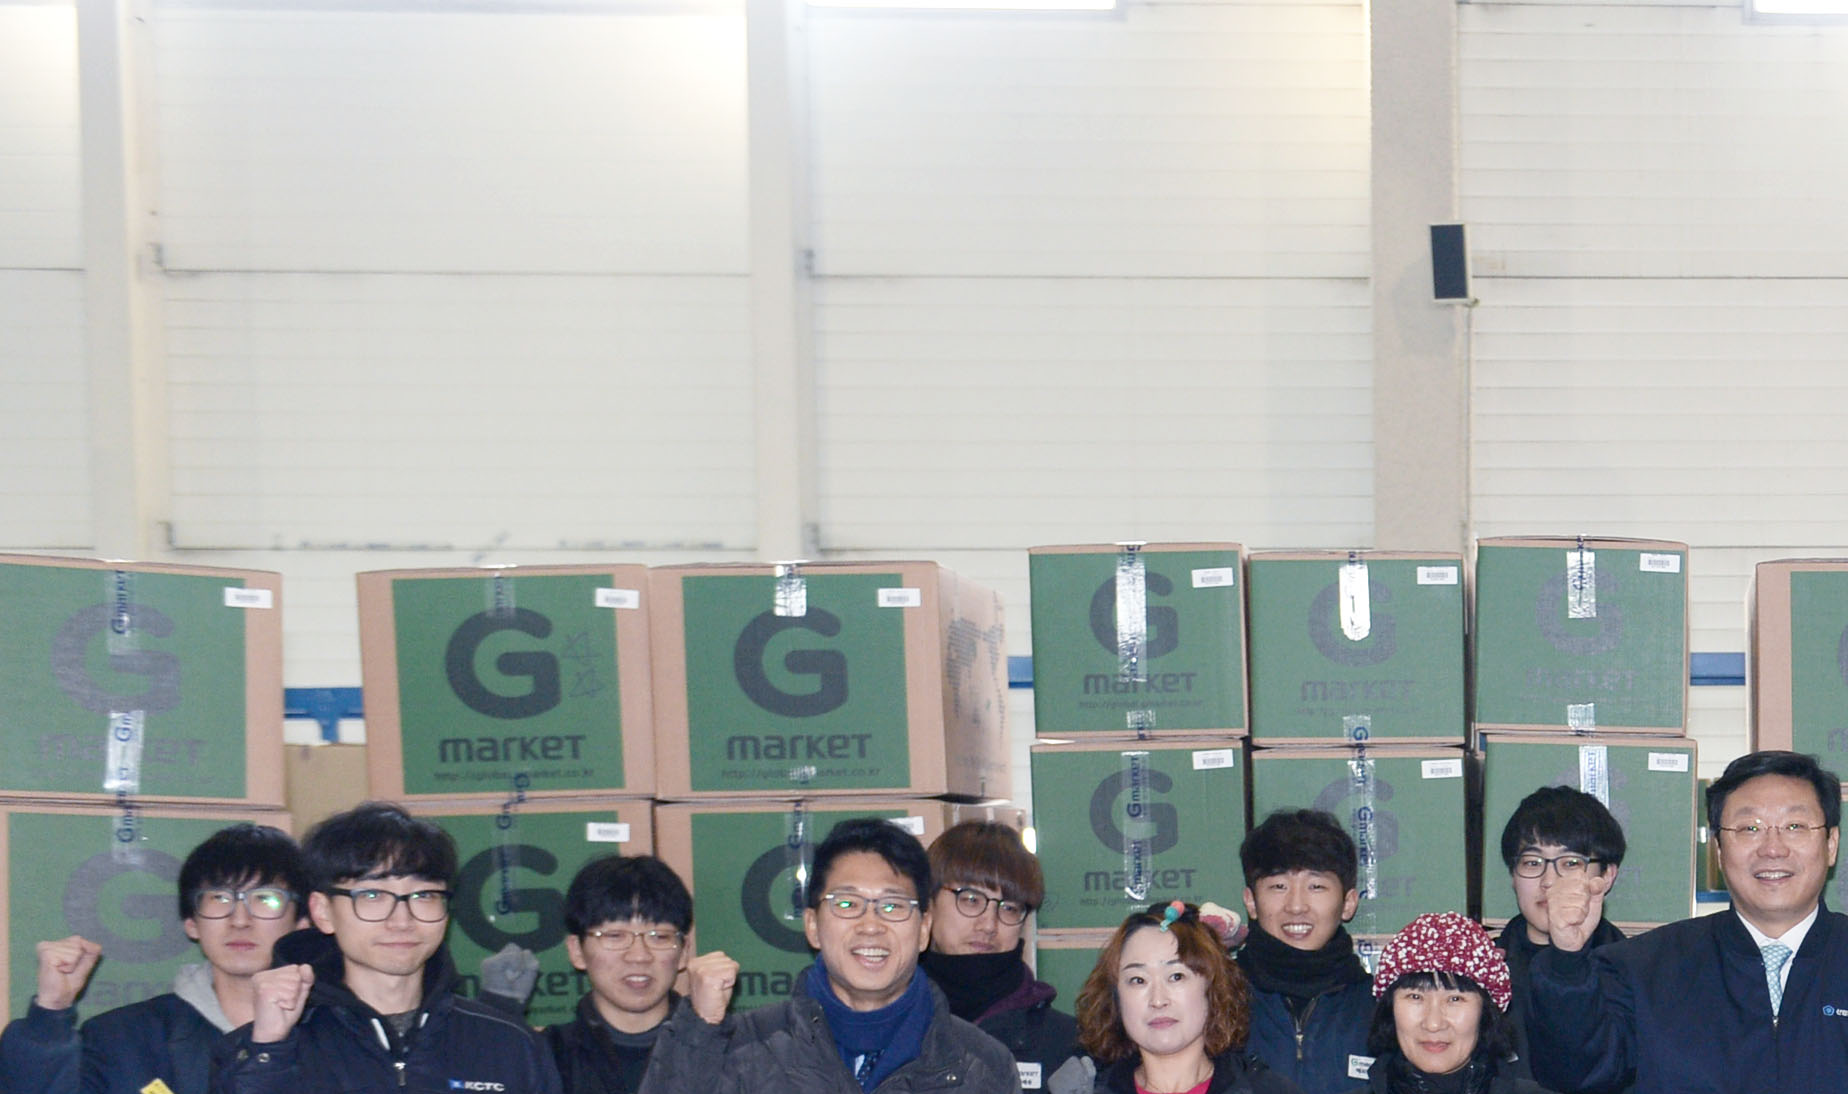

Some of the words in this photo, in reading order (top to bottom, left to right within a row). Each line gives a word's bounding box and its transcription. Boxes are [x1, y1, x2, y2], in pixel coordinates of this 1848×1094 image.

[1089, 572, 1178, 659] G
[1307, 578, 1397, 667] G
[53, 602, 182, 716] G
[445, 607, 561, 720] G
[734, 606, 848, 718] G
[1083, 671, 1197, 695] market
[1301, 680, 1416, 702] market
[438, 734, 586, 763] market
[725, 733, 872, 761] market
[1089, 768, 1178, 856] G
[1126, 757, 1142, 818] Gmarket
[452, 844, 568, 953] G
[1083, 868, 1197, 892] maket
[464, 1081, 505, 1092] KCTC
